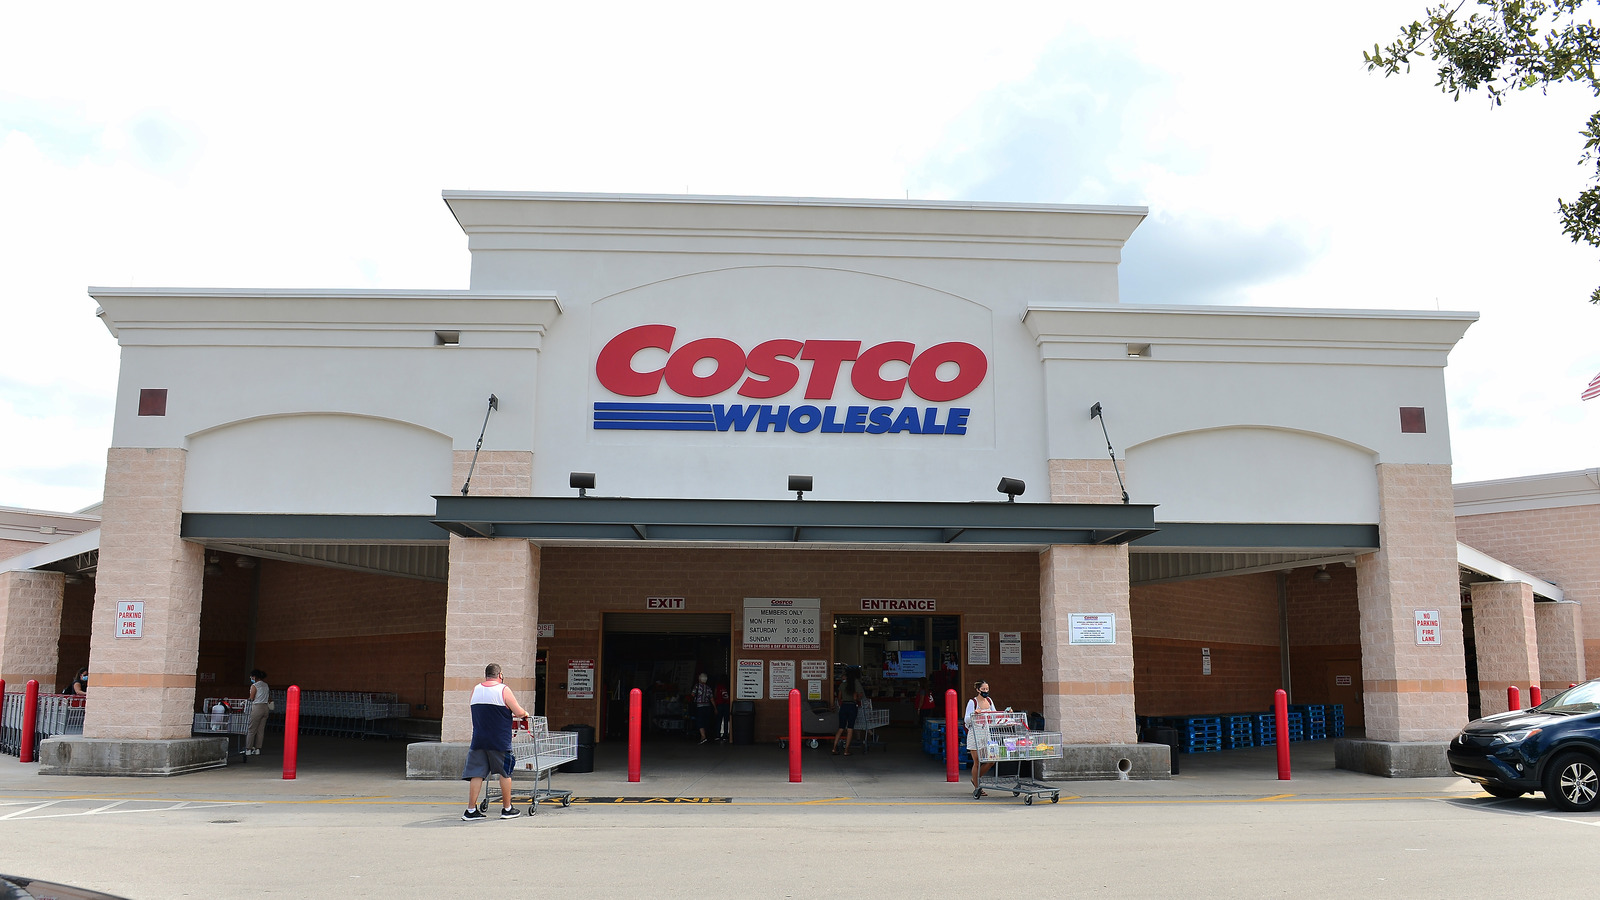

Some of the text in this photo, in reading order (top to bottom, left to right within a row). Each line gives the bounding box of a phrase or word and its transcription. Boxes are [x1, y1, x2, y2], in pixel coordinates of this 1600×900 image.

[595, 323, 988, 402] COSTCO
[712, 404, 971, 435] WHOLESALE
[648, 598, 683, 608] EXIT
[862, 599, 935, 610] ENTRANCE
